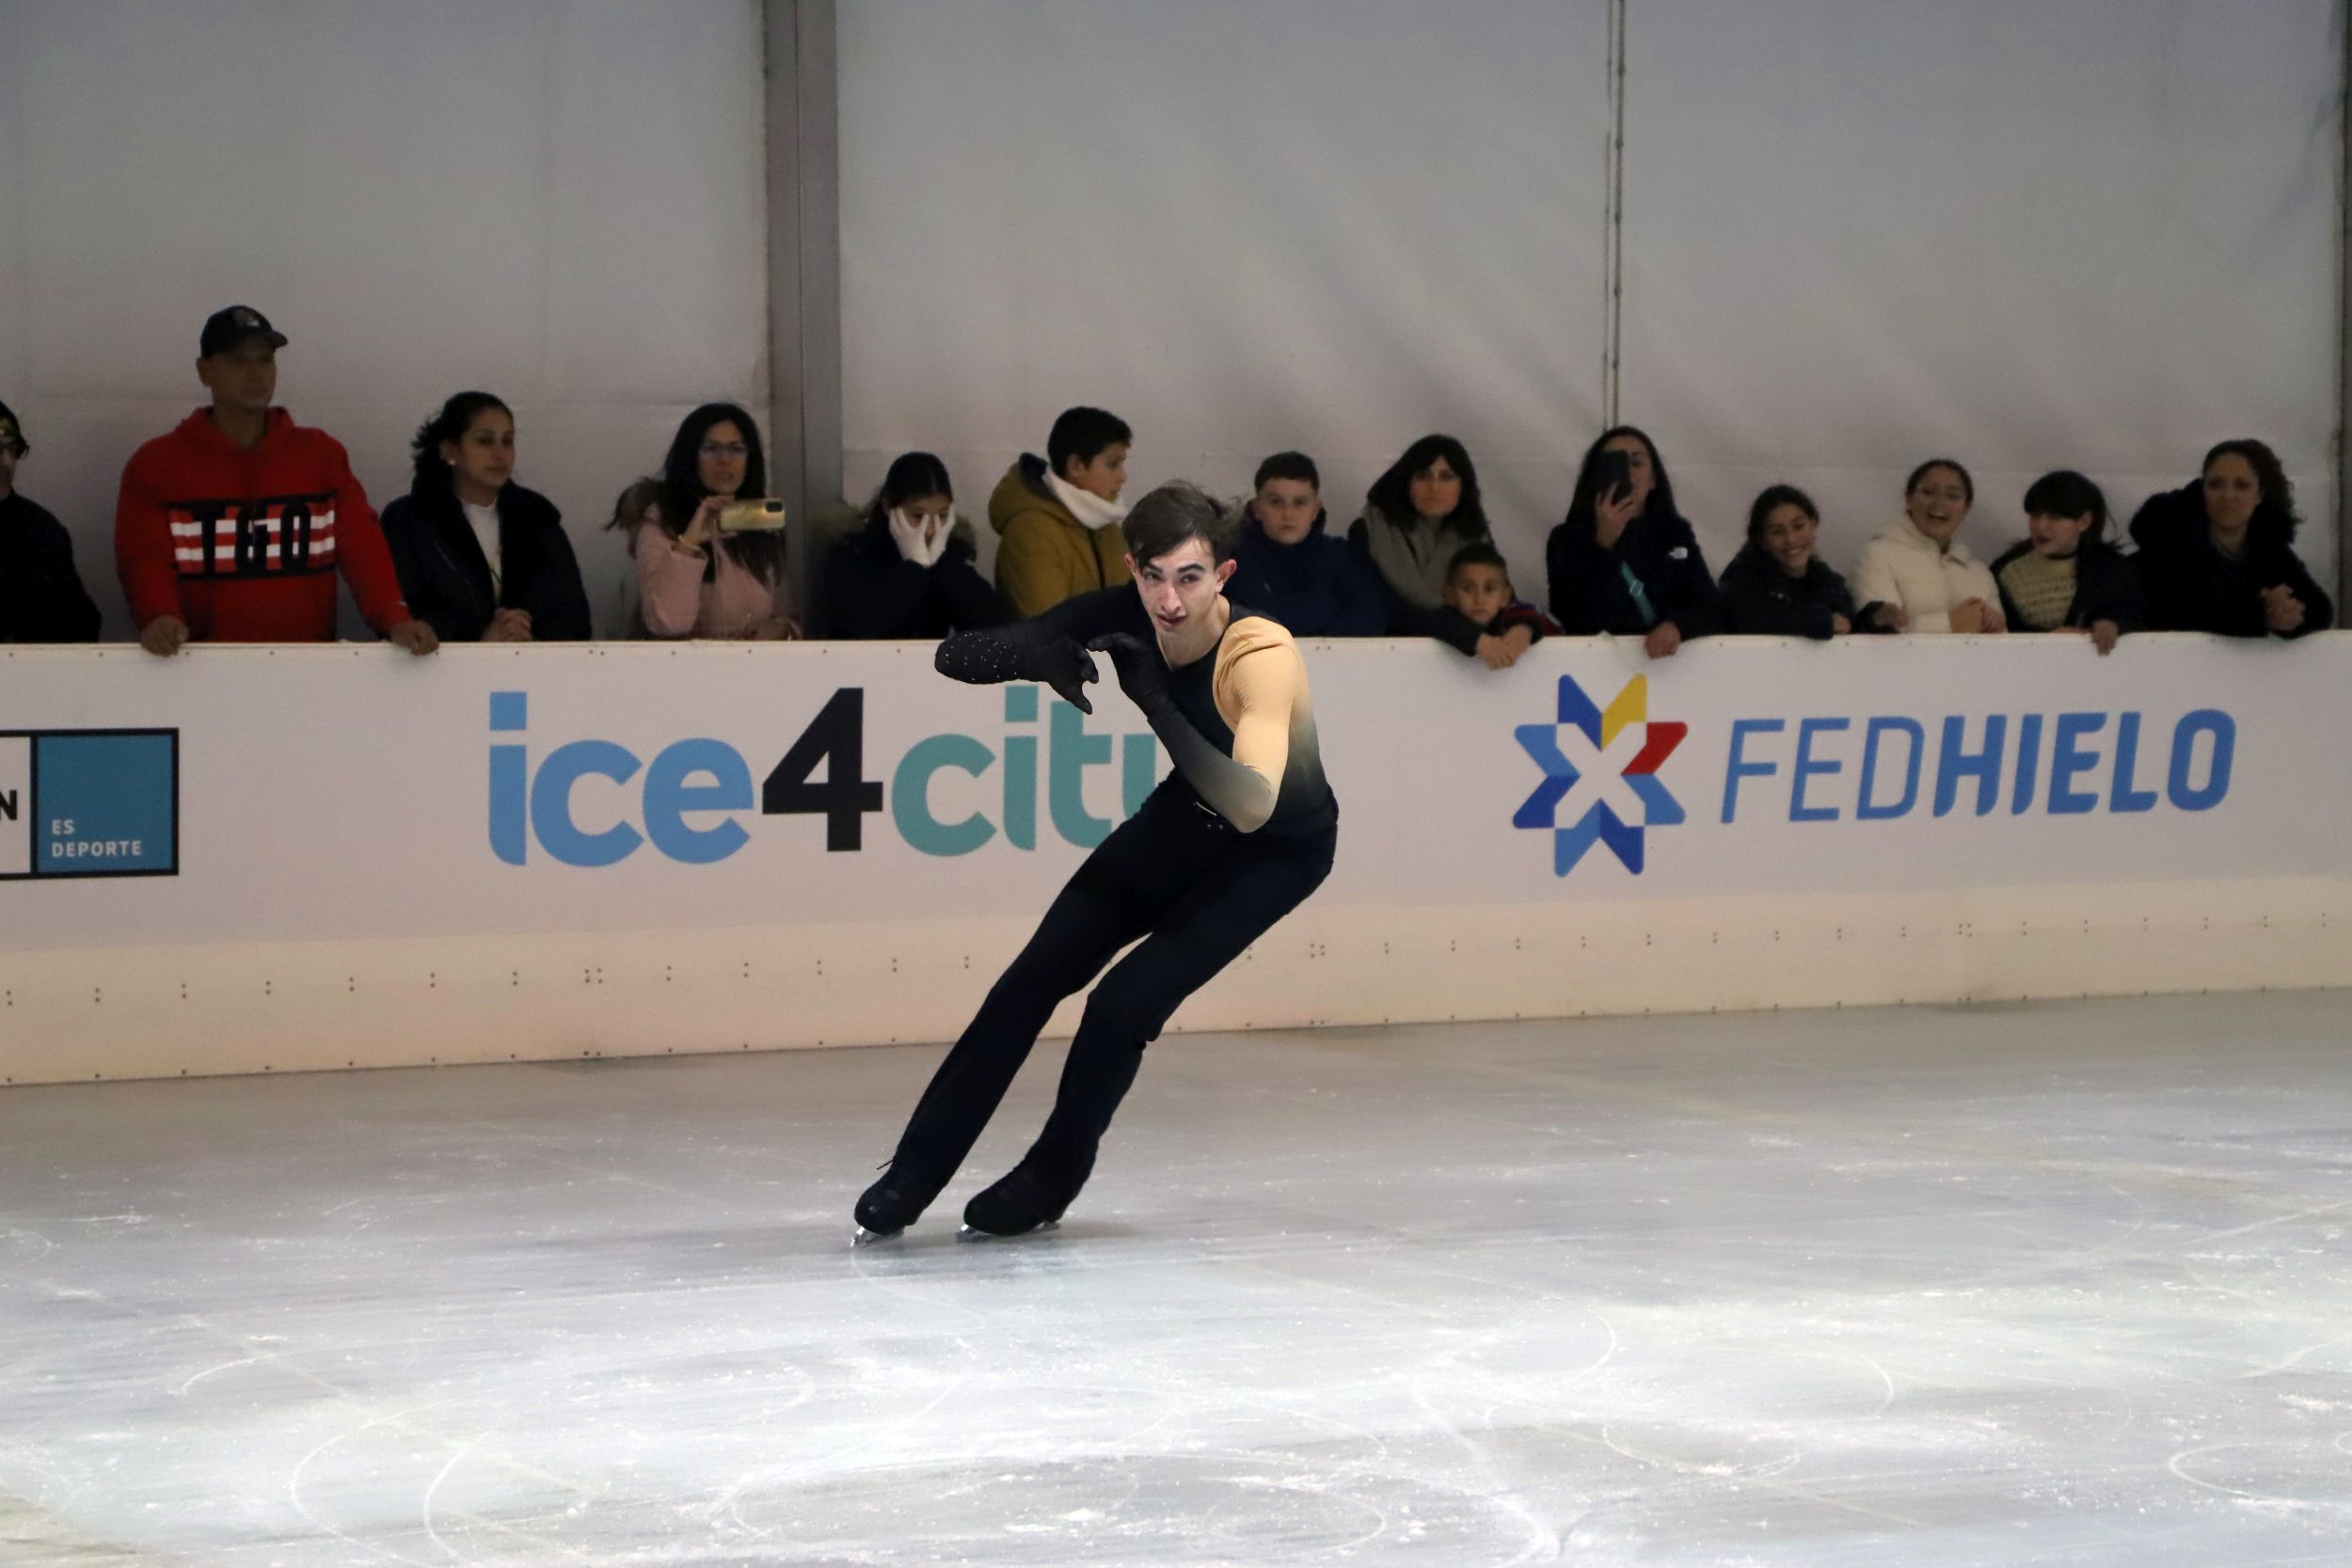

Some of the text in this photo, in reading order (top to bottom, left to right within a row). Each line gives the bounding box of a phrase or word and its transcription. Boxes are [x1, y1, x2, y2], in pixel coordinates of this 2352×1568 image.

[1721, 708, 2237, 824] FEDHIELO
[51, 819, 74, 835] ES
[51, 840, 142, 858] DEPORTE
